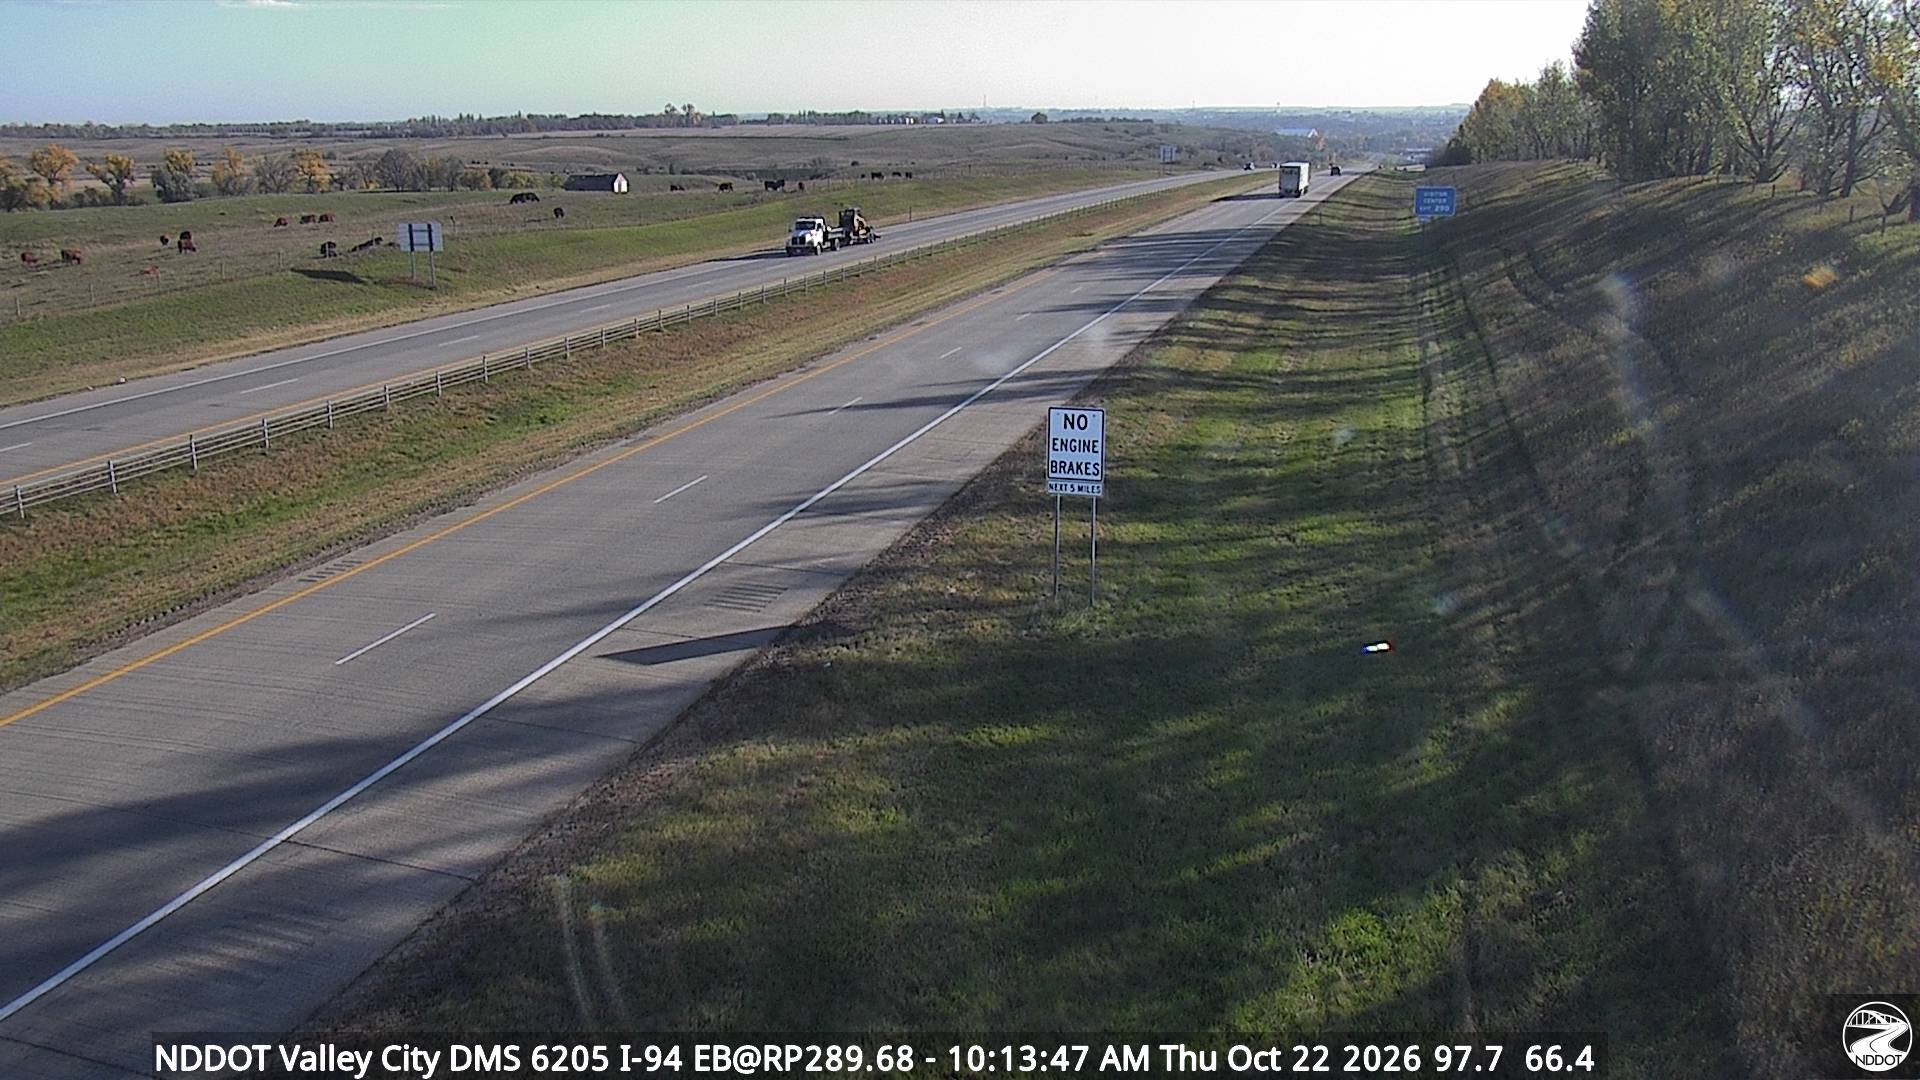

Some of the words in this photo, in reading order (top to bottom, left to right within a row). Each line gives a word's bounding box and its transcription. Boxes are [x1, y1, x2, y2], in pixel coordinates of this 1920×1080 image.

[1063, 413, 1088, 431] NO
[1052, 437, 1099, 453] ENGINE
[1050, 460, 1100, 476] BRAKES
[1048, 483, 1067, 492] NEXT
[1070, 484, 1076, 492] 5
[1077, 485, 1101, 494] MILES
